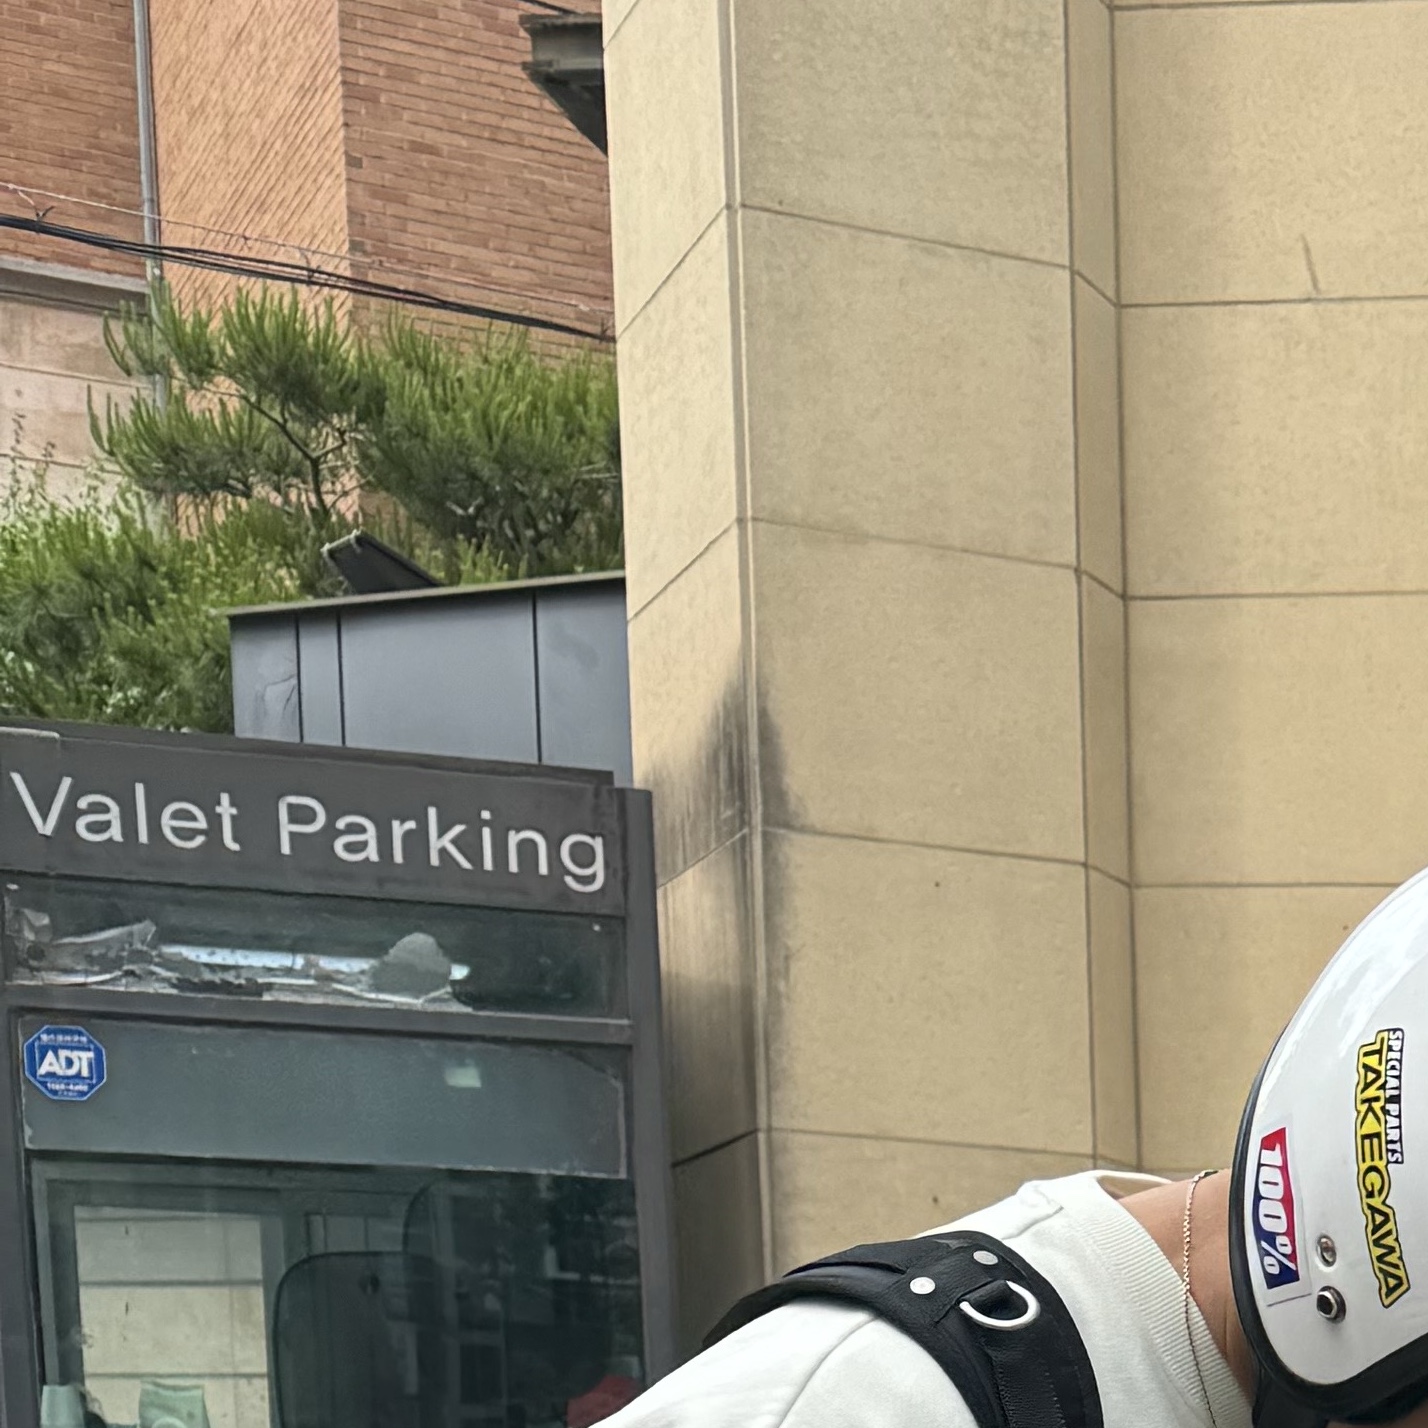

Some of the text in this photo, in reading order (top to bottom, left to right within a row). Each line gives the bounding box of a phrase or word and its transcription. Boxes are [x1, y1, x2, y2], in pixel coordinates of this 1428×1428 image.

[10, 771, 606, 893] Valet Parking
[39, 1048, 94, 1078] ADT
[1359, 1035, 1406, 1300] TAKEGAWA
[1386, 1103, 1403, 1162] PARTS
[1258, 1145, 1298, 1276] 100%
